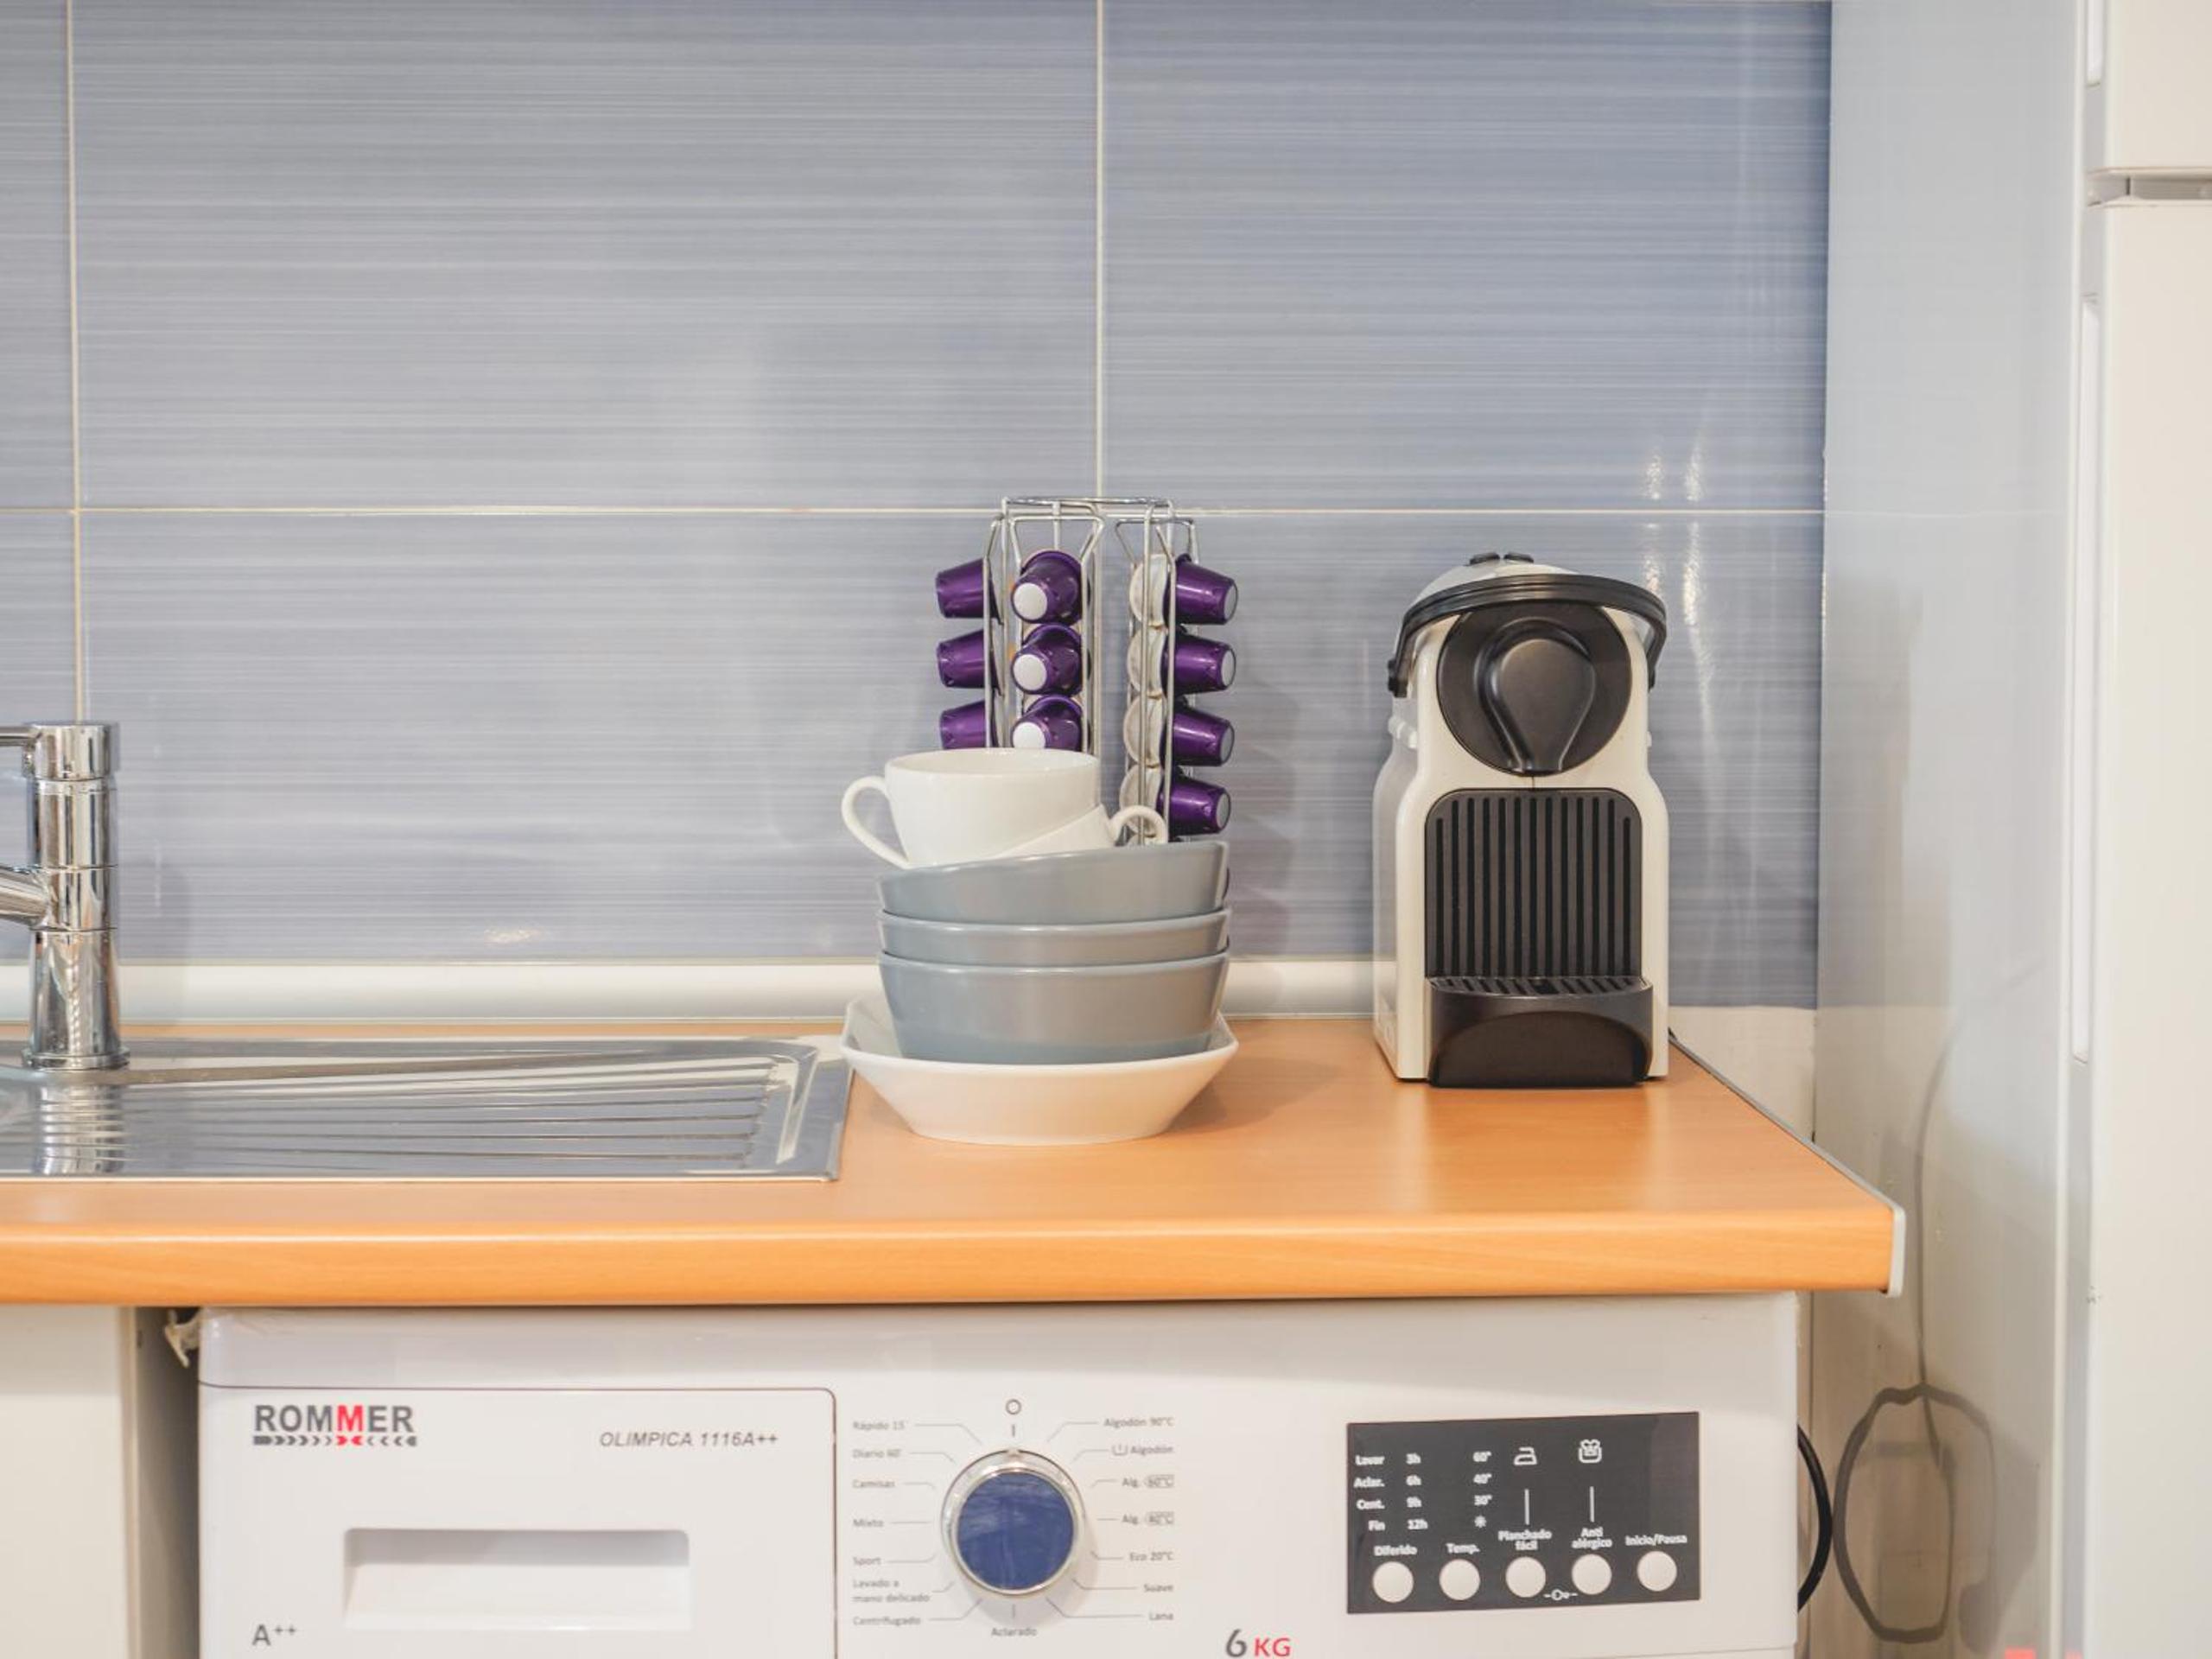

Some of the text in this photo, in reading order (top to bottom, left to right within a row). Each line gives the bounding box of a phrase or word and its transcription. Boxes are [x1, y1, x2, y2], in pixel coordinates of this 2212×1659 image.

[254, 1404, 415, 1433] ROMMER
[599, 1431, 779, 1448] OLIMPICA 1116A++
[1624, 1534, 1688, 1547] Inicio/Pausa
[1225, 1628, 1291, 1657] 6 KG
